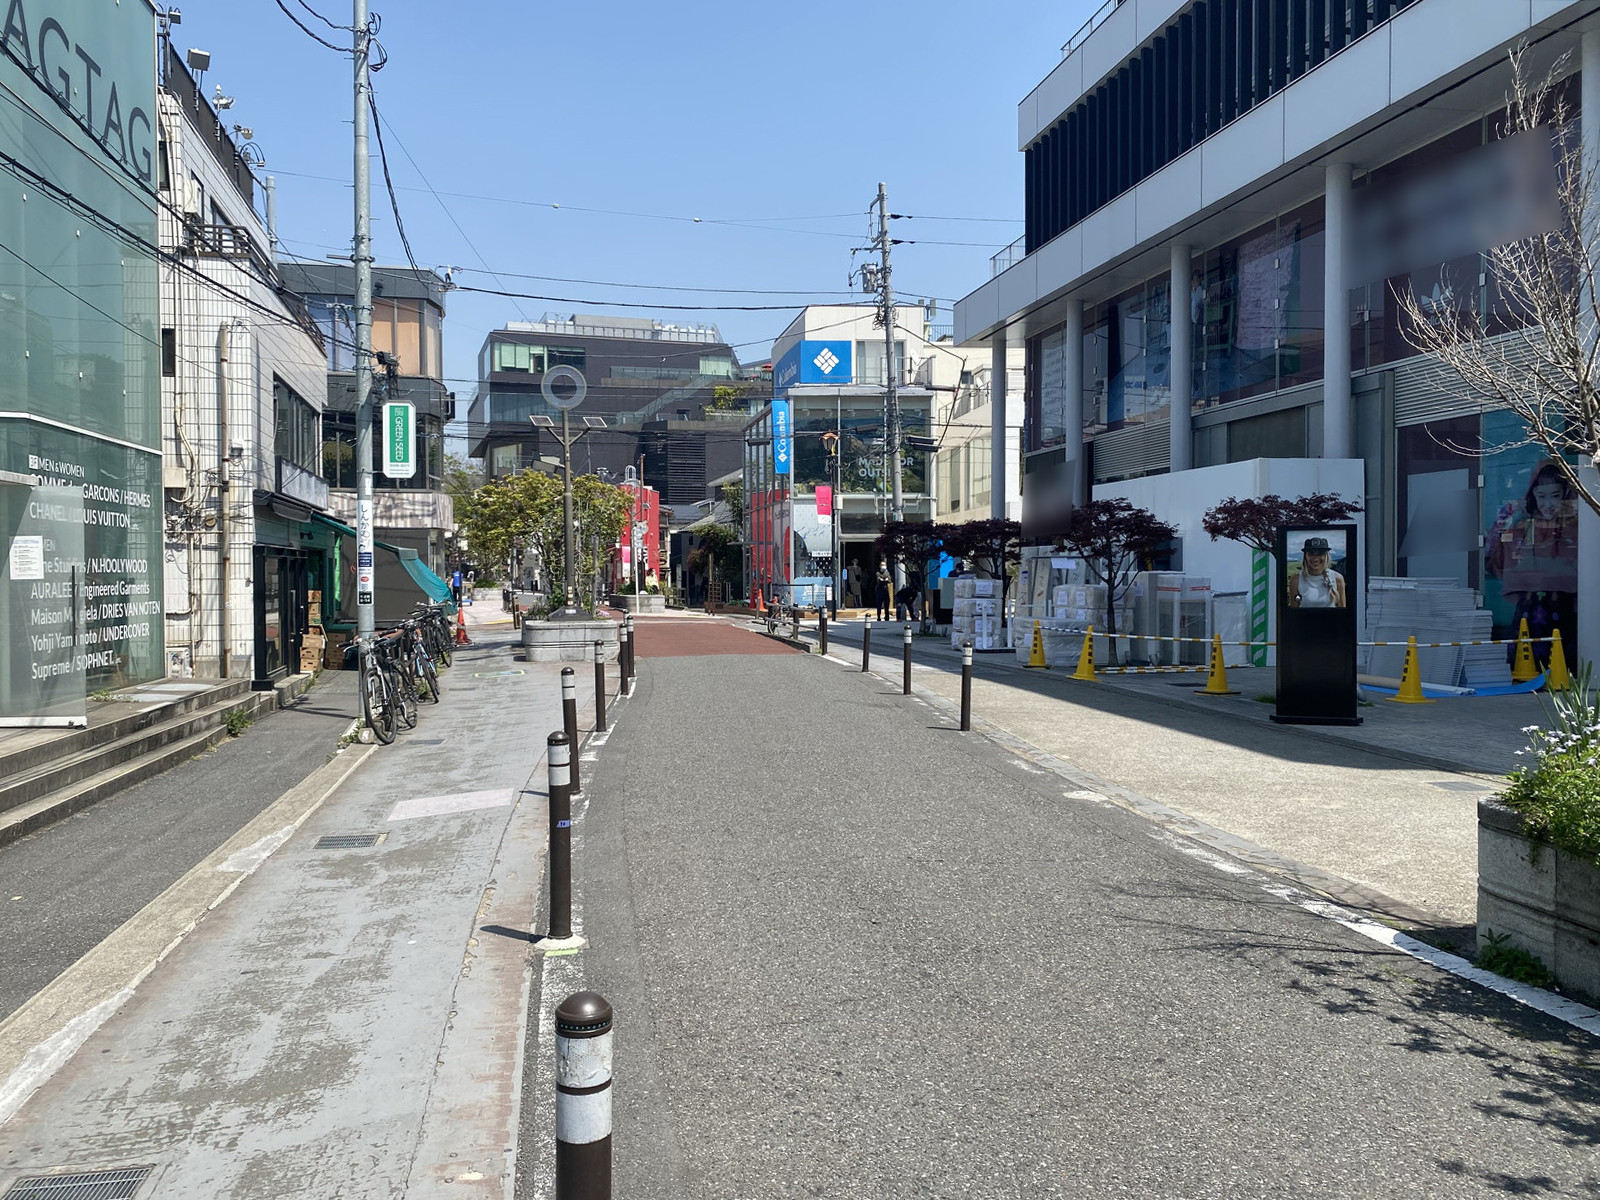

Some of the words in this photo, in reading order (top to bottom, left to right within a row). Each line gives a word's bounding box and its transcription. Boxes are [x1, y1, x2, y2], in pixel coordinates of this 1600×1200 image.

[395, 416, 404, 442] GREEN
[777, 411, 787, 453] Coumbia
[395, 442, 404, 462] SEED
[858, 468, 905, 477] OUTSIE
[82, 483, 120, 504] GARCONS
[124, 490, 151, 508] HERMES
[97, 509, 131, 528] VUITTON
[31, 581, 72, 599] AURALEE
[120, 581, 150, 595] Garments
[31, 607, 62, 625] Maison
[103, 602, 124, 619] DRIES
[124, 601, 139, 617] VAN
[31, 633, 54, 653] Yohji
[55, 630, 97, 647] Yammoto
[103, 622, 150, 642] UNDERCOVER
[31, 661, 70, 681] Supreme
